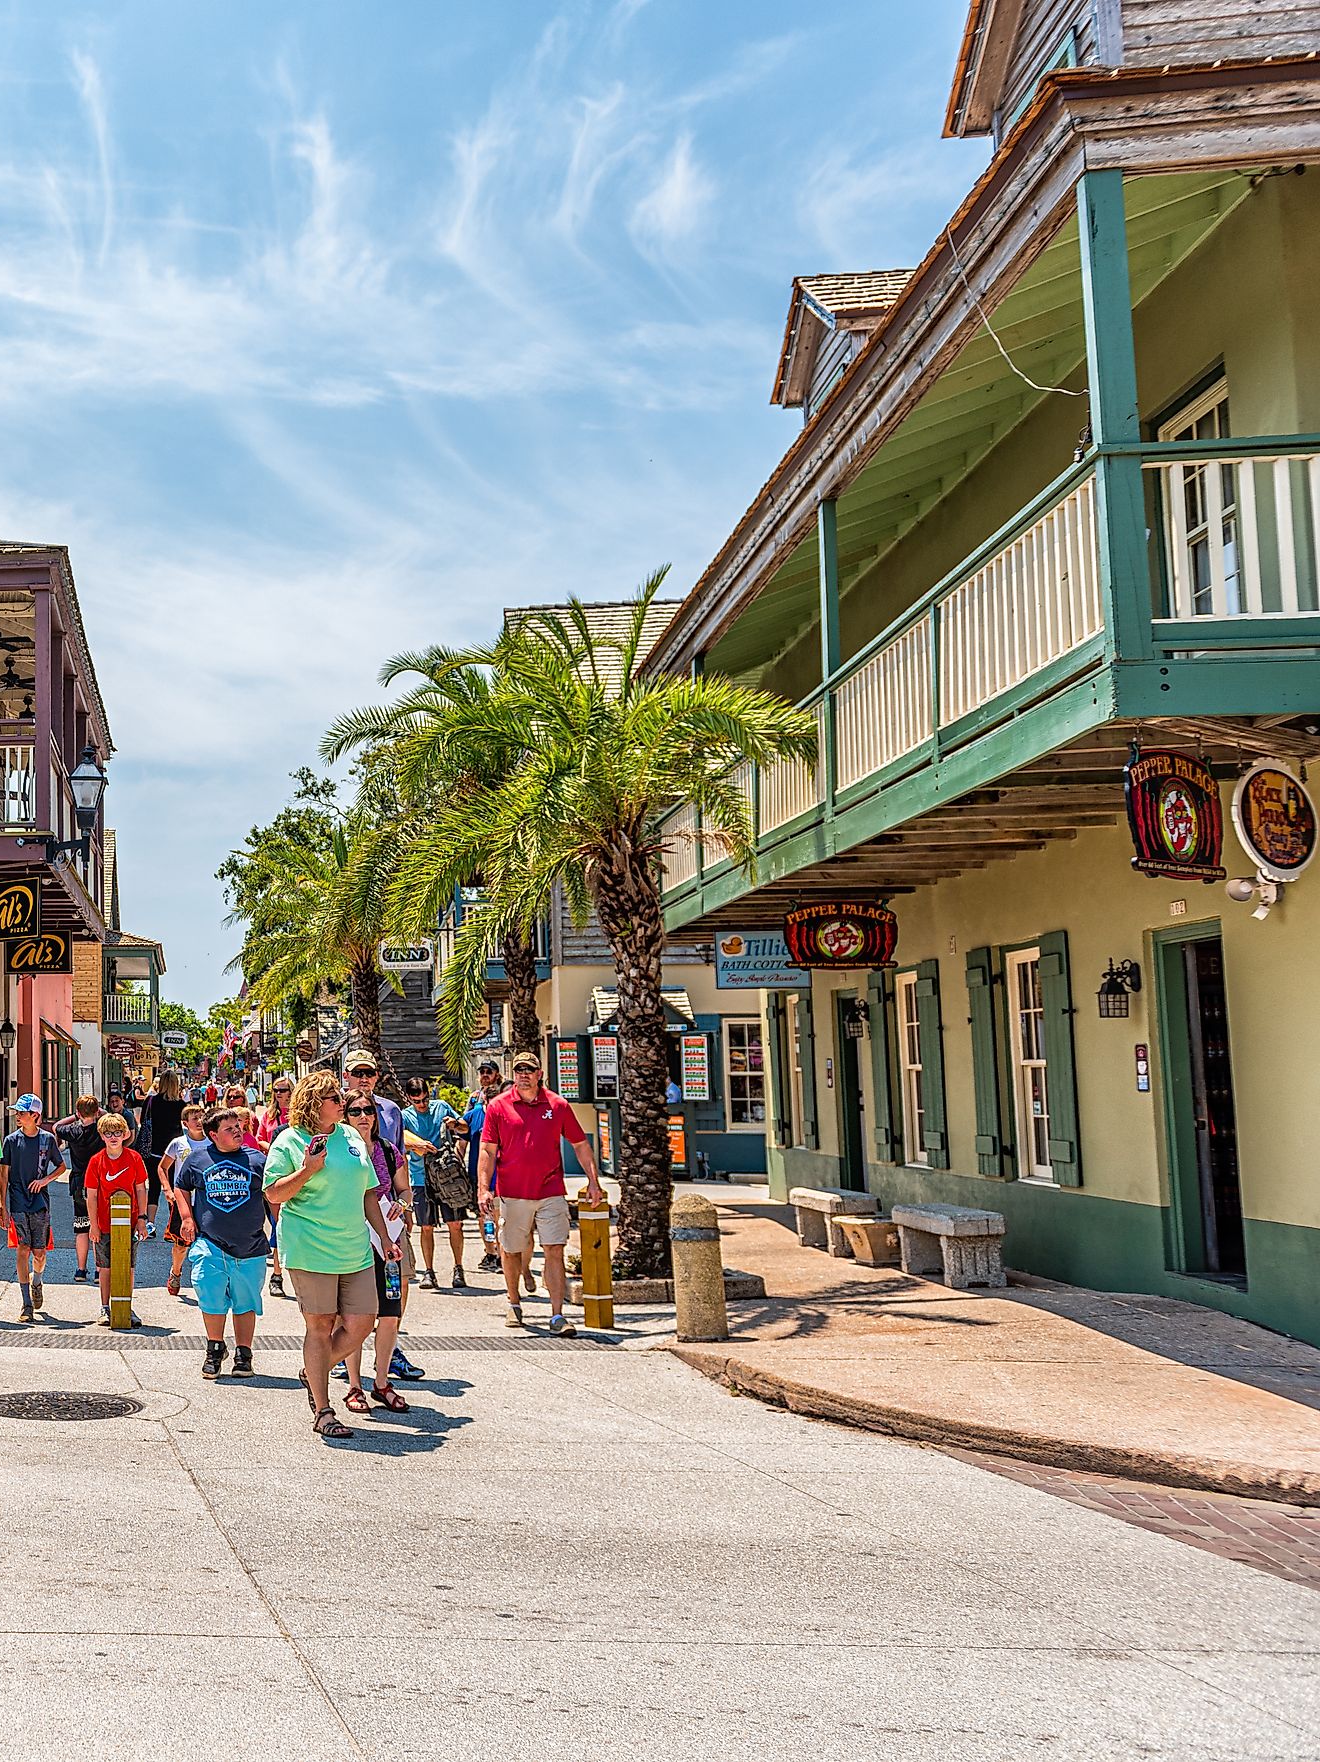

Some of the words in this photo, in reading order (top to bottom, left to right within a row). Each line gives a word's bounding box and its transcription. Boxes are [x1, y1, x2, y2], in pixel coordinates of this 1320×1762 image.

[1130, 756, 1172, 787] PEPPER
[1174, 757, 1218, 799] PALACE
[1171, 902, 1185, 914] 102
[786, 904, 838, 925] PEPPER
[841, 904, 895, 923] PALACE
[390, 950, 421, 960] INN
[721, 960, 751, 969] BATH
[206, 1181, 248, 1191] COLUMBIA
